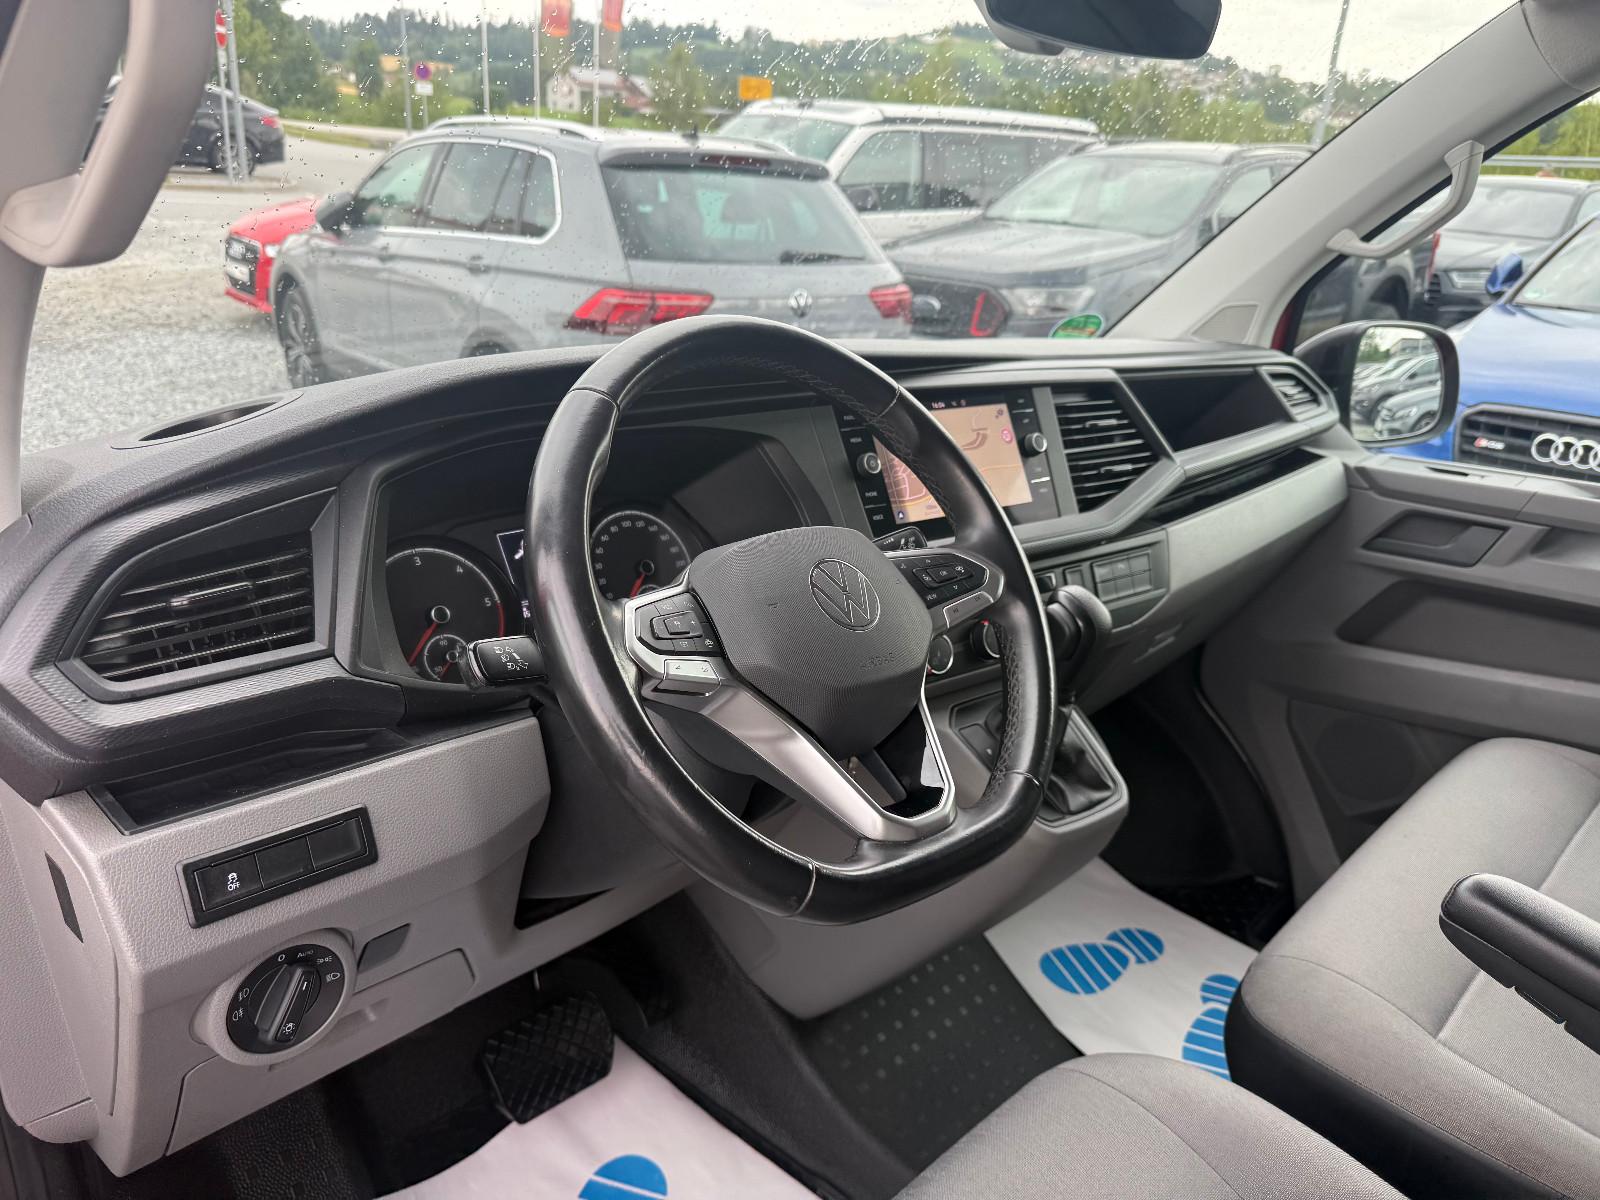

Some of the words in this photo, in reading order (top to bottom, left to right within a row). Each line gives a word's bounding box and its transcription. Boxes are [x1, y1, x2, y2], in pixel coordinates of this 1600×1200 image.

[414, 556, 422, 566] 3
[456, 565, 464, 573] 4
[484, 597, 492, 607] 5
[228, 882, 240, 891] OFF
